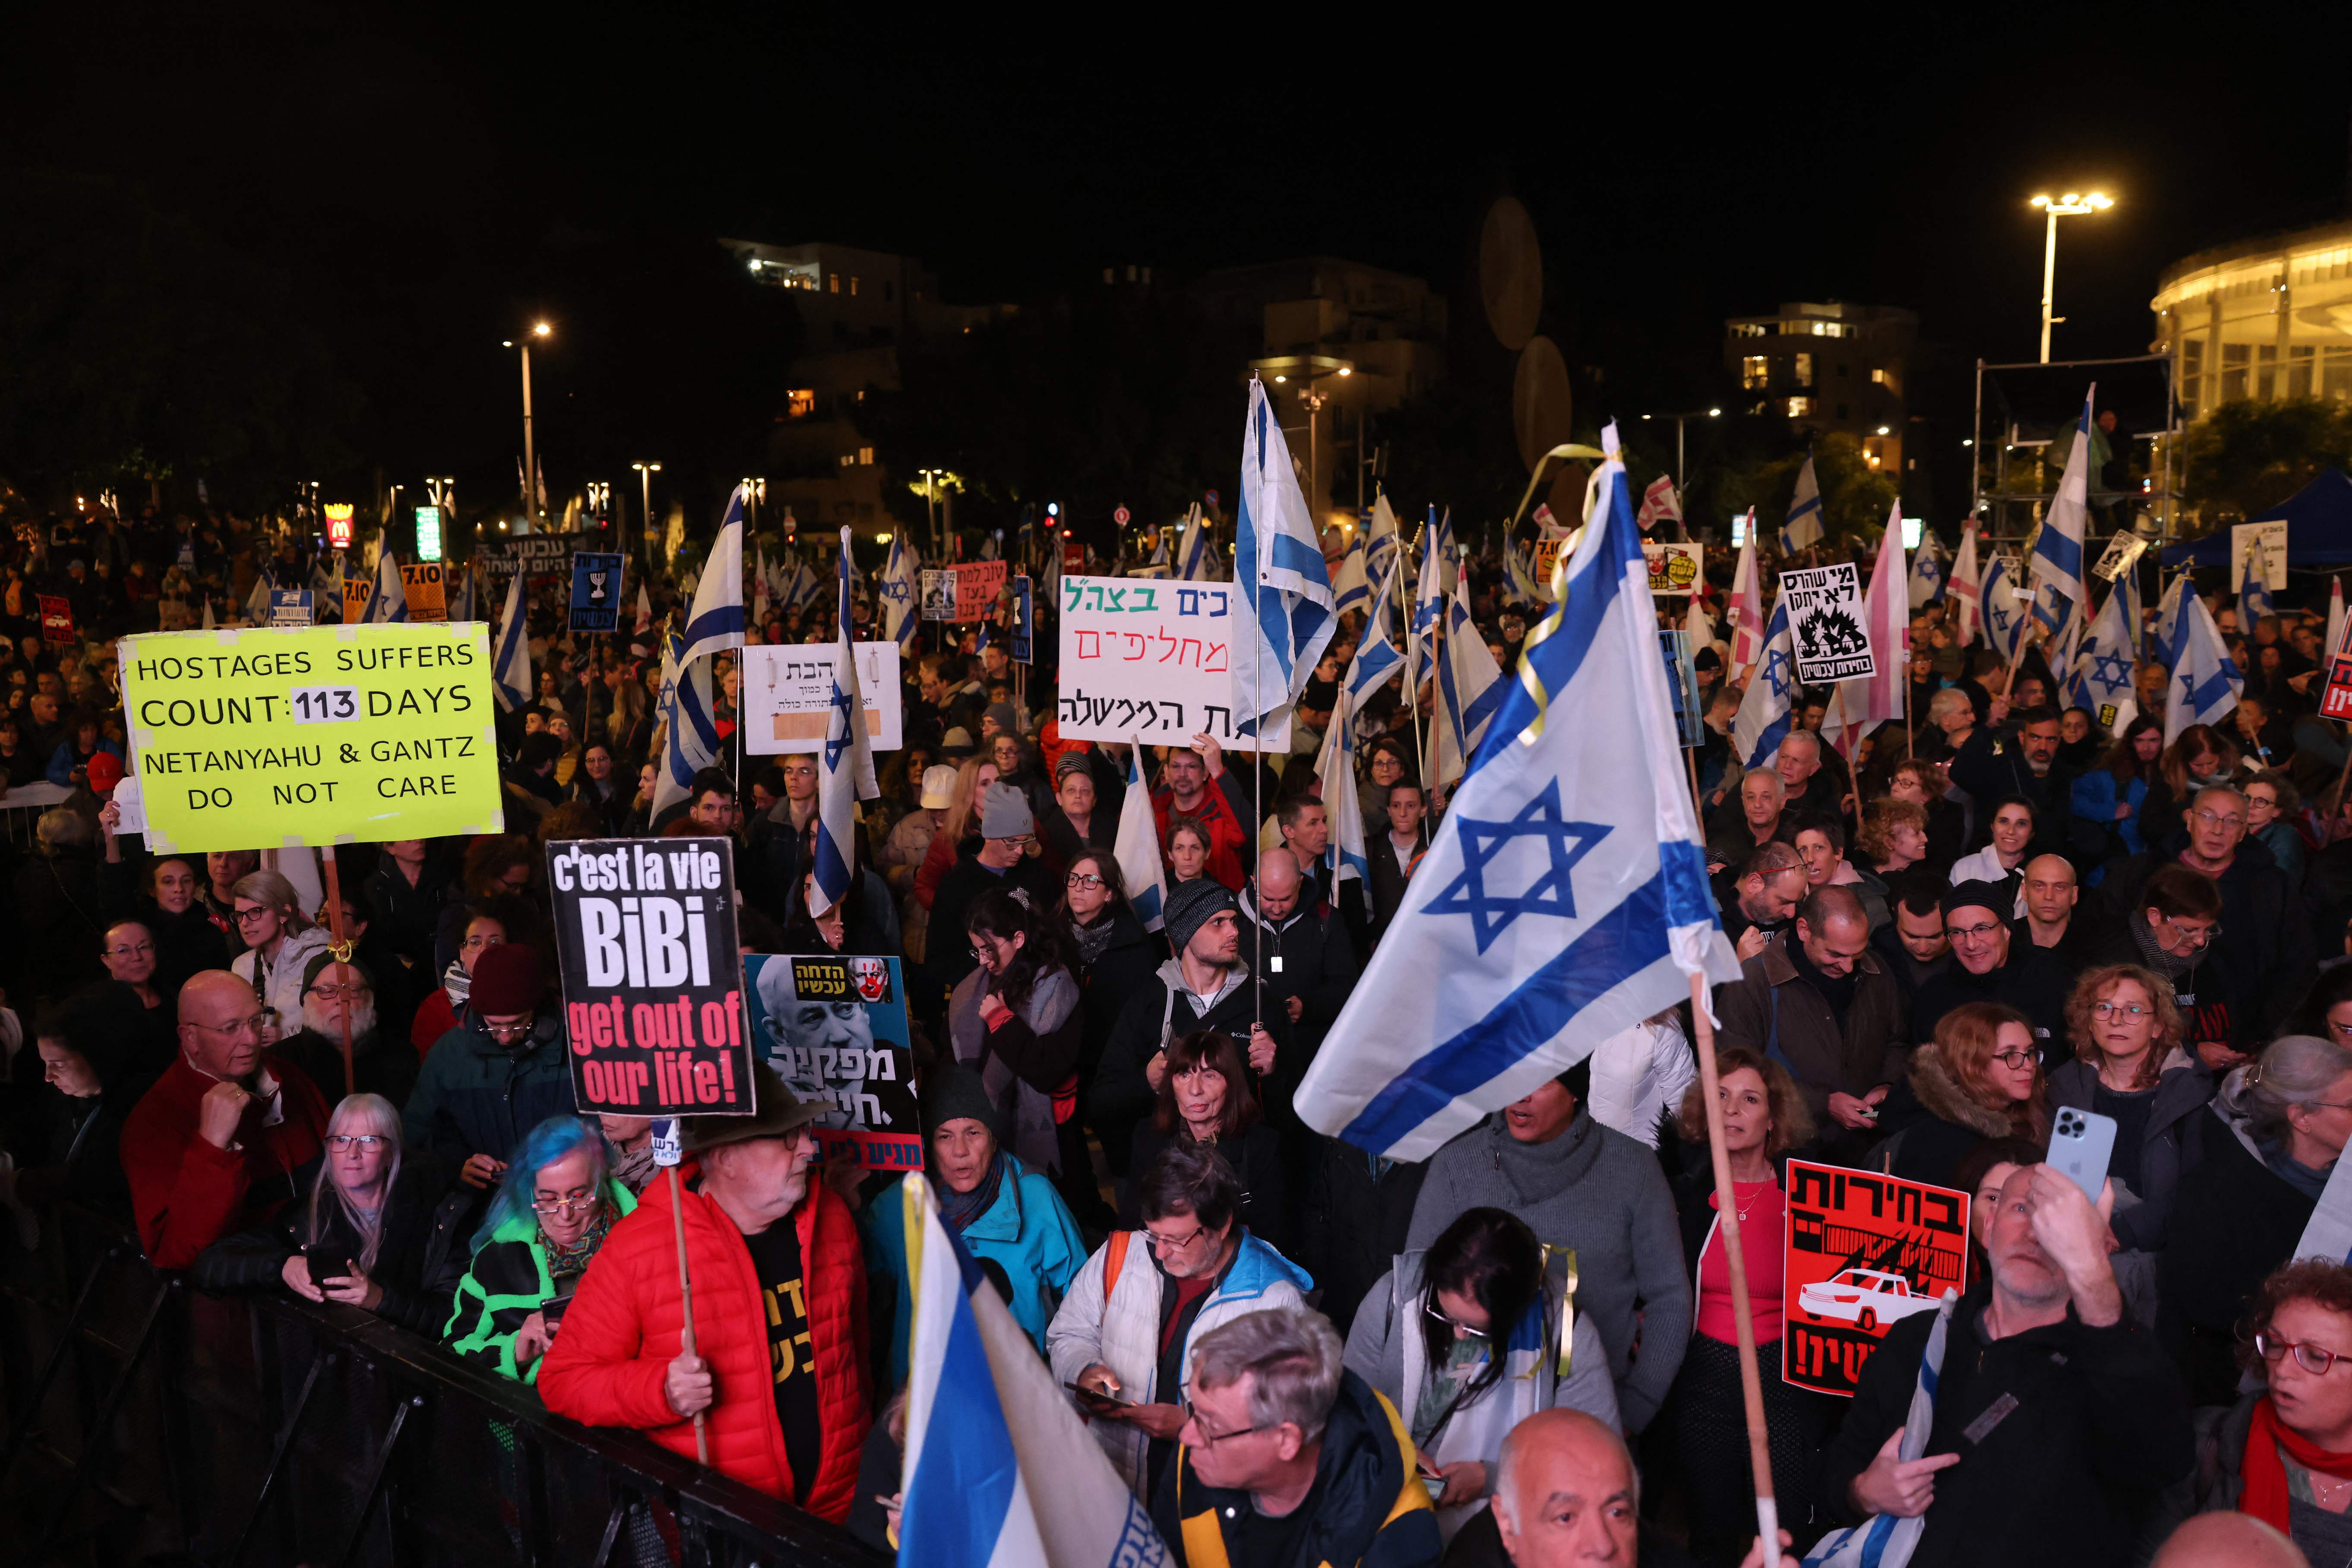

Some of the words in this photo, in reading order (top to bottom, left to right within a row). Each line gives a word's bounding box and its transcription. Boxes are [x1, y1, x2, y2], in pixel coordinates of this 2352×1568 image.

[403, 566, 440, 585] 7.10
[1783, 571, 1827, 590] שהרס
[1829, 566, 1854, 583] מי
[1176, 588, 1233, 616] כים
[1789, 591, 1820, 611] יתקן
[1824, 585, 1854, 604] לא
[138, 652, 310, 680] HOSTAGES
[338, 644, 472, 670] SUFFERS
[1075, 626, 1228, 672] מחליפים
[787, 662, 836, 680] הבת
[1837, 658, 1871, 673] בחירות
[142, 696, 291, 726] COUNT:
[296, 691, 354, 718] 113
[369, 685, 471, 716] DAYS
[799, 686, 820, 695] כמוך
[805, 699, 831, 708] תורה
[1059, 689, 1183, 730] הממשלה
[146, 746, 320, 774] NETANYAHU
[340, 744, 361, 763] &
[371, 737, 474, 761] GANTZ
[188, 788, 232, 809] DO
[274, 782, 338, 805] NOT
[378, 775, 456, 797] CARE
[554, 846, 631, 891] c'est
[634, 845, 665, 890] la
[669, 844, 721, 889] vie
[579, 896, 710, 987] BiBi
[796, 965, 844, 979] הדחה
[798, 980, 845, 994] עכשיו
[569, 996, 628, 1055] get
[632, 995, 695, 1048] out
[701, 991, 740, 1047] of
[583, 1060, 648, 1105] our
[654, 1050, 736, 1105] life!
[771, 1046, 896, 1088] מפקיר
[868, 1143, 921, 1165] מגיע
[1791, 1167, 1963, 1236] בחירות
[1795, 1329, 1876, 1384] שיו!
